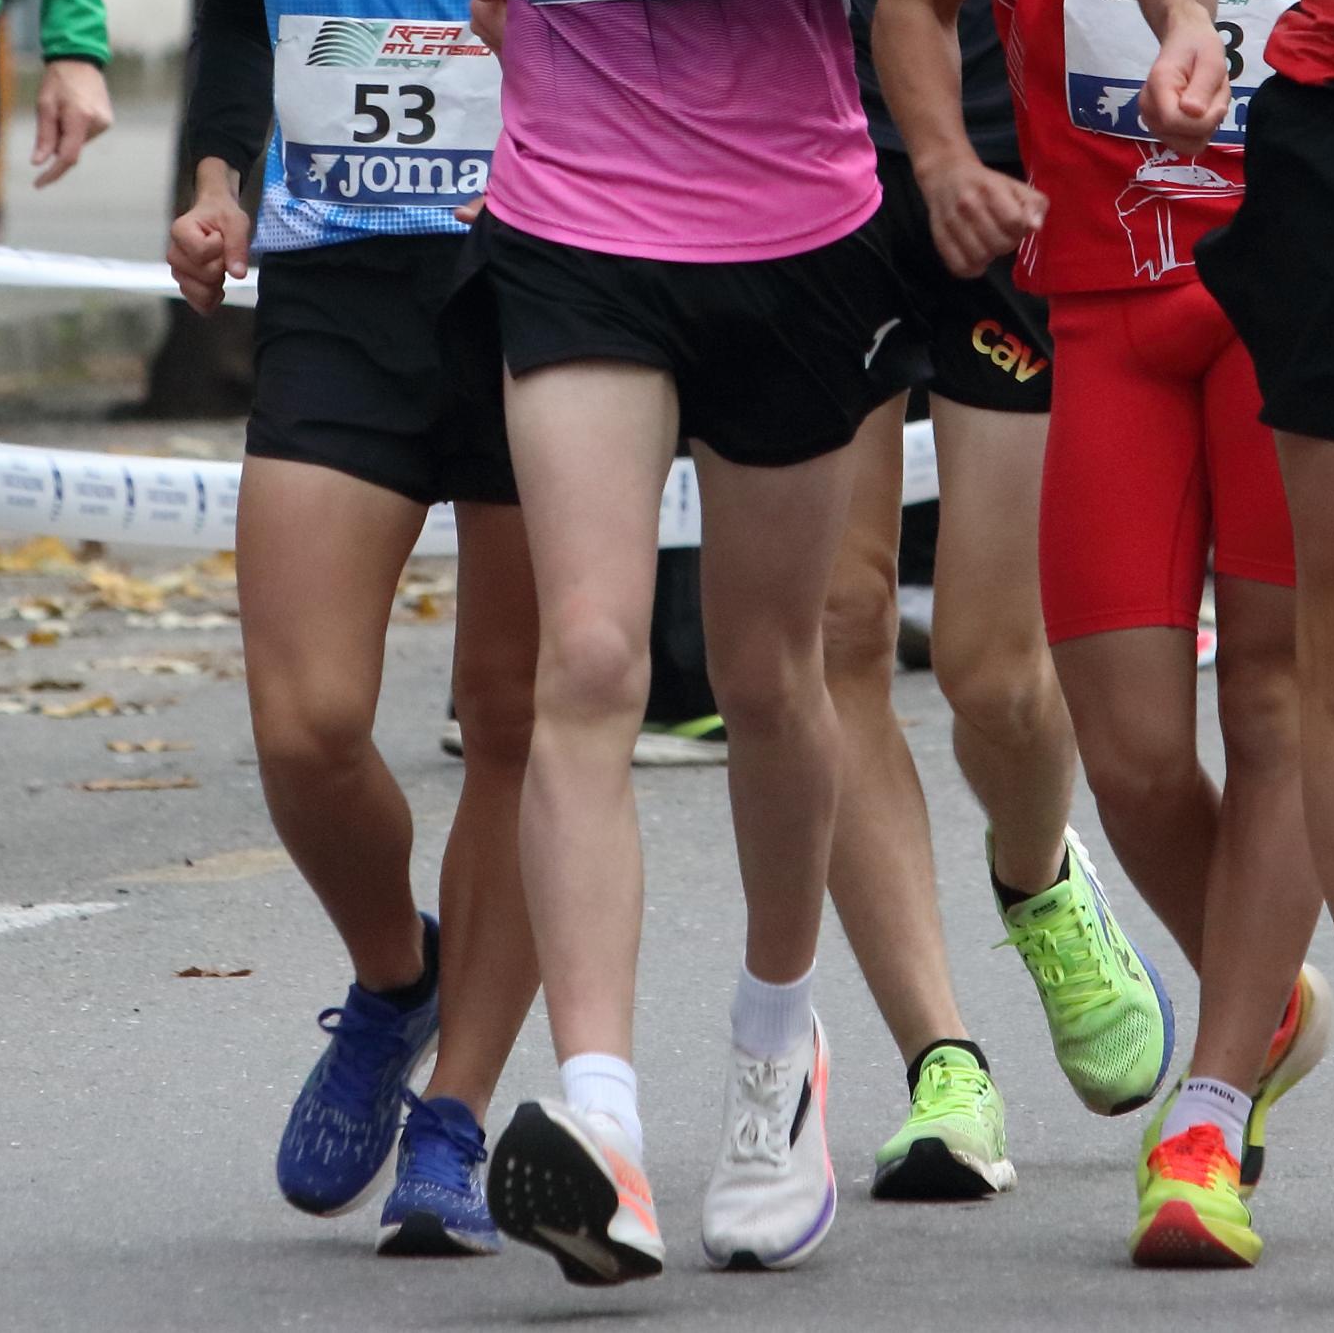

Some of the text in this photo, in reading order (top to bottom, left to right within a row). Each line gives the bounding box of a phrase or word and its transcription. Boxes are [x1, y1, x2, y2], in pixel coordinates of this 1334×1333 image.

[381, 43, 492, 57] ATLETISMO
[388, 25, 463, 42] RFEA
[352, 83, 436, 145] 53
[972, 319, 1048, 383] cav
